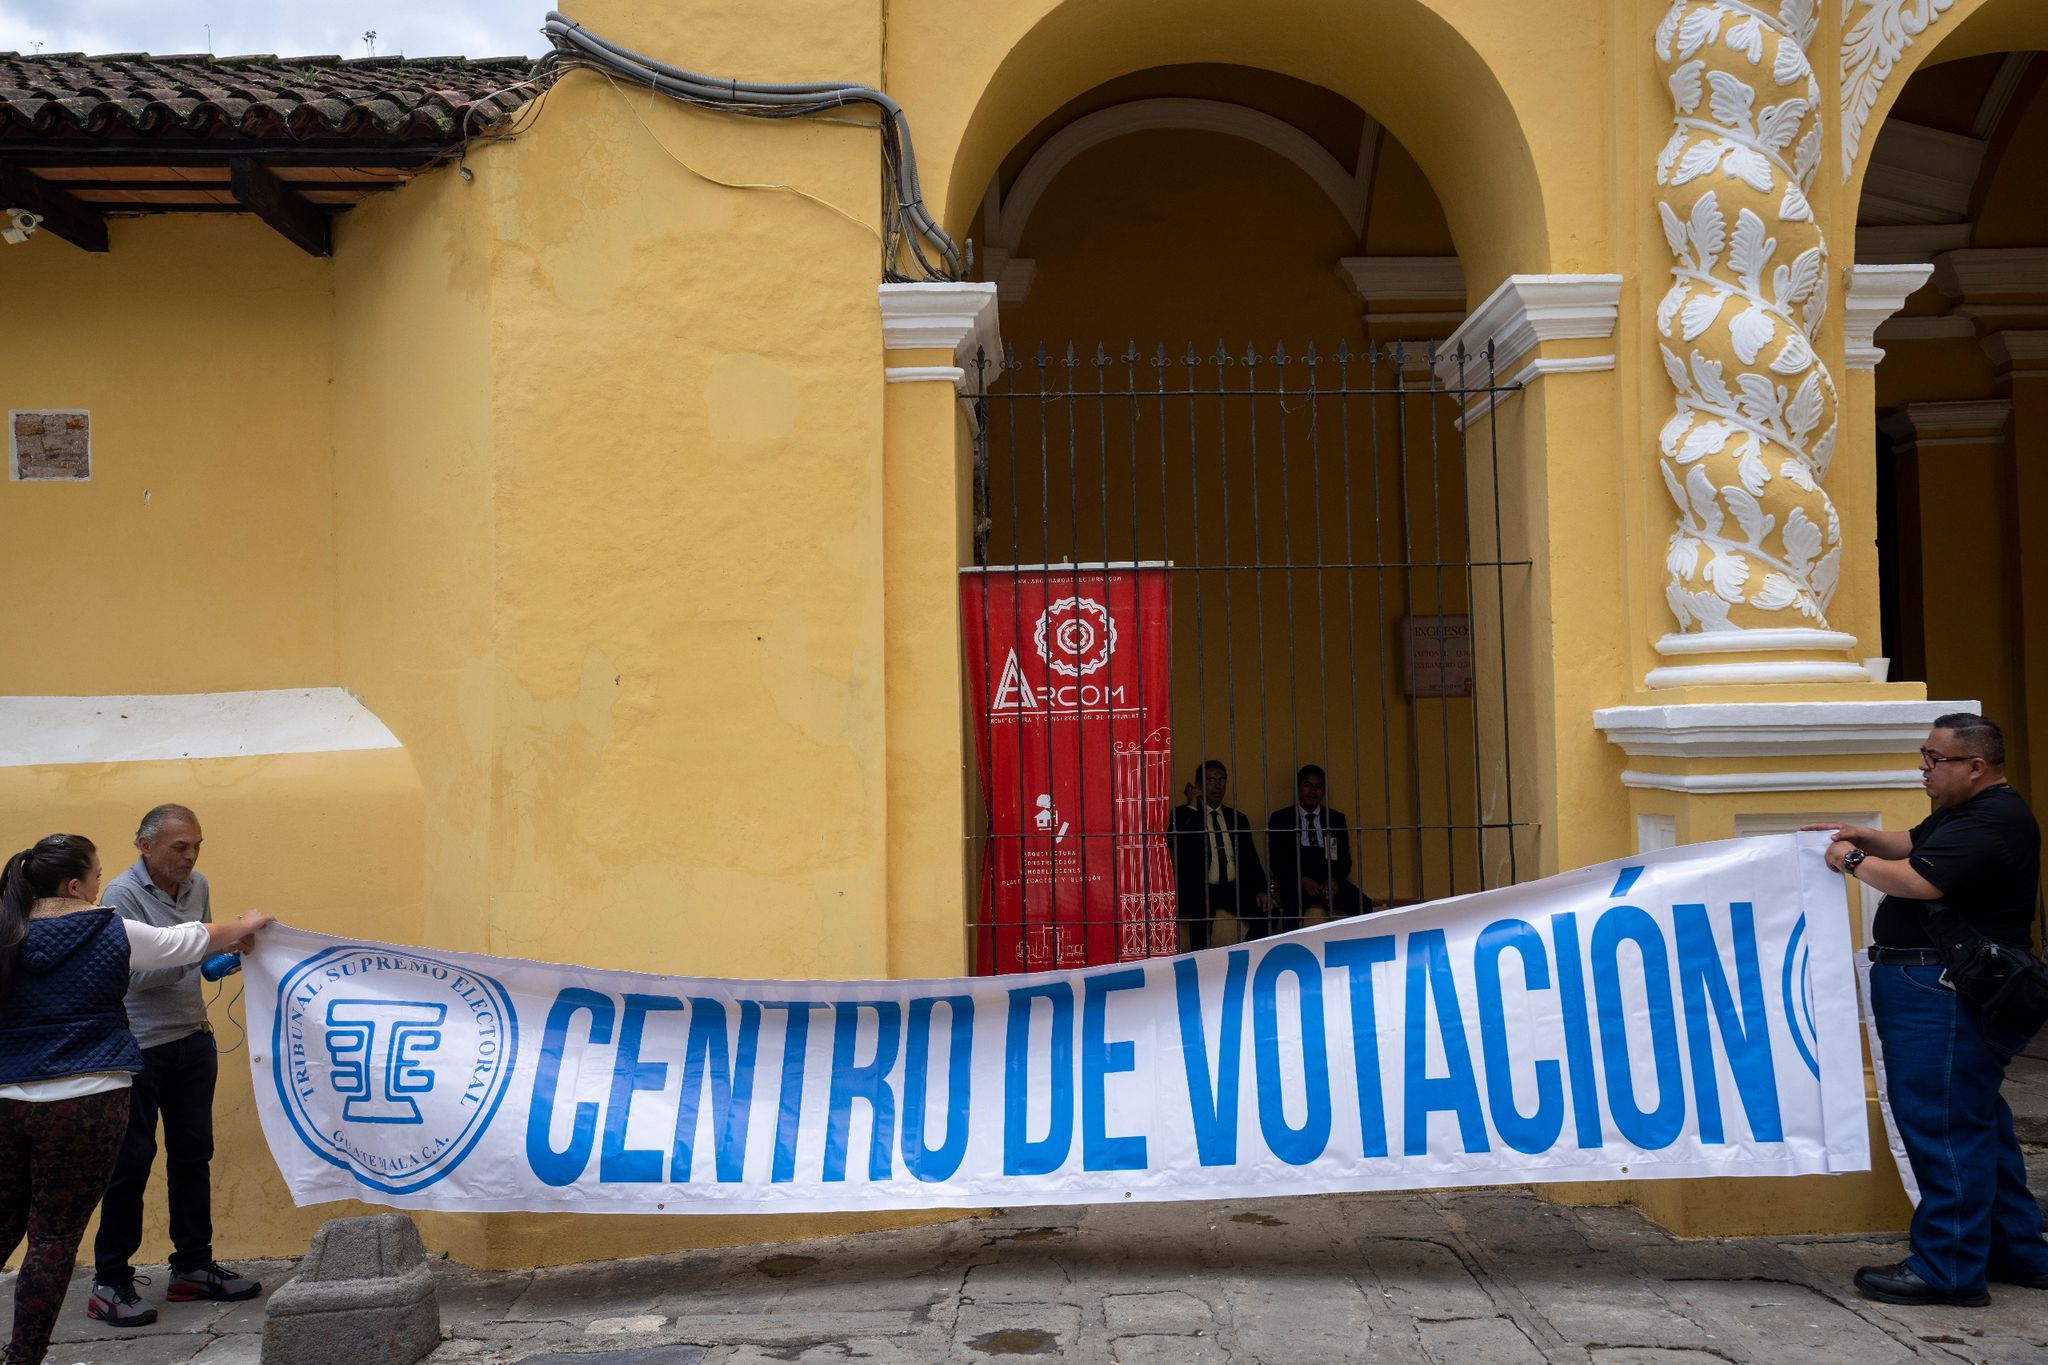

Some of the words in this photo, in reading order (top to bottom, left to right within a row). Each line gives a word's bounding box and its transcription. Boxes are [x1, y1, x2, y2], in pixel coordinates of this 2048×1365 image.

[1415, 626, 1470, 637] INGRESO
[993, 647, 1124, 709] ARCOM
[1070, 875, 1101, 883] GESIÓN
[291, 982, 324, 1102] TRIBUNAL
[326, 956, 449, 983] SUPREMO
[450, 976, 496, 1107] ELECTORAL
[526, 987, 975, 1187] CENTRO
[1003, 968, 1148, 1177] DE
[1173, 865, 1784, 1167] VOTACIÓN
[422, 1136, 450, 1159] C.A.
